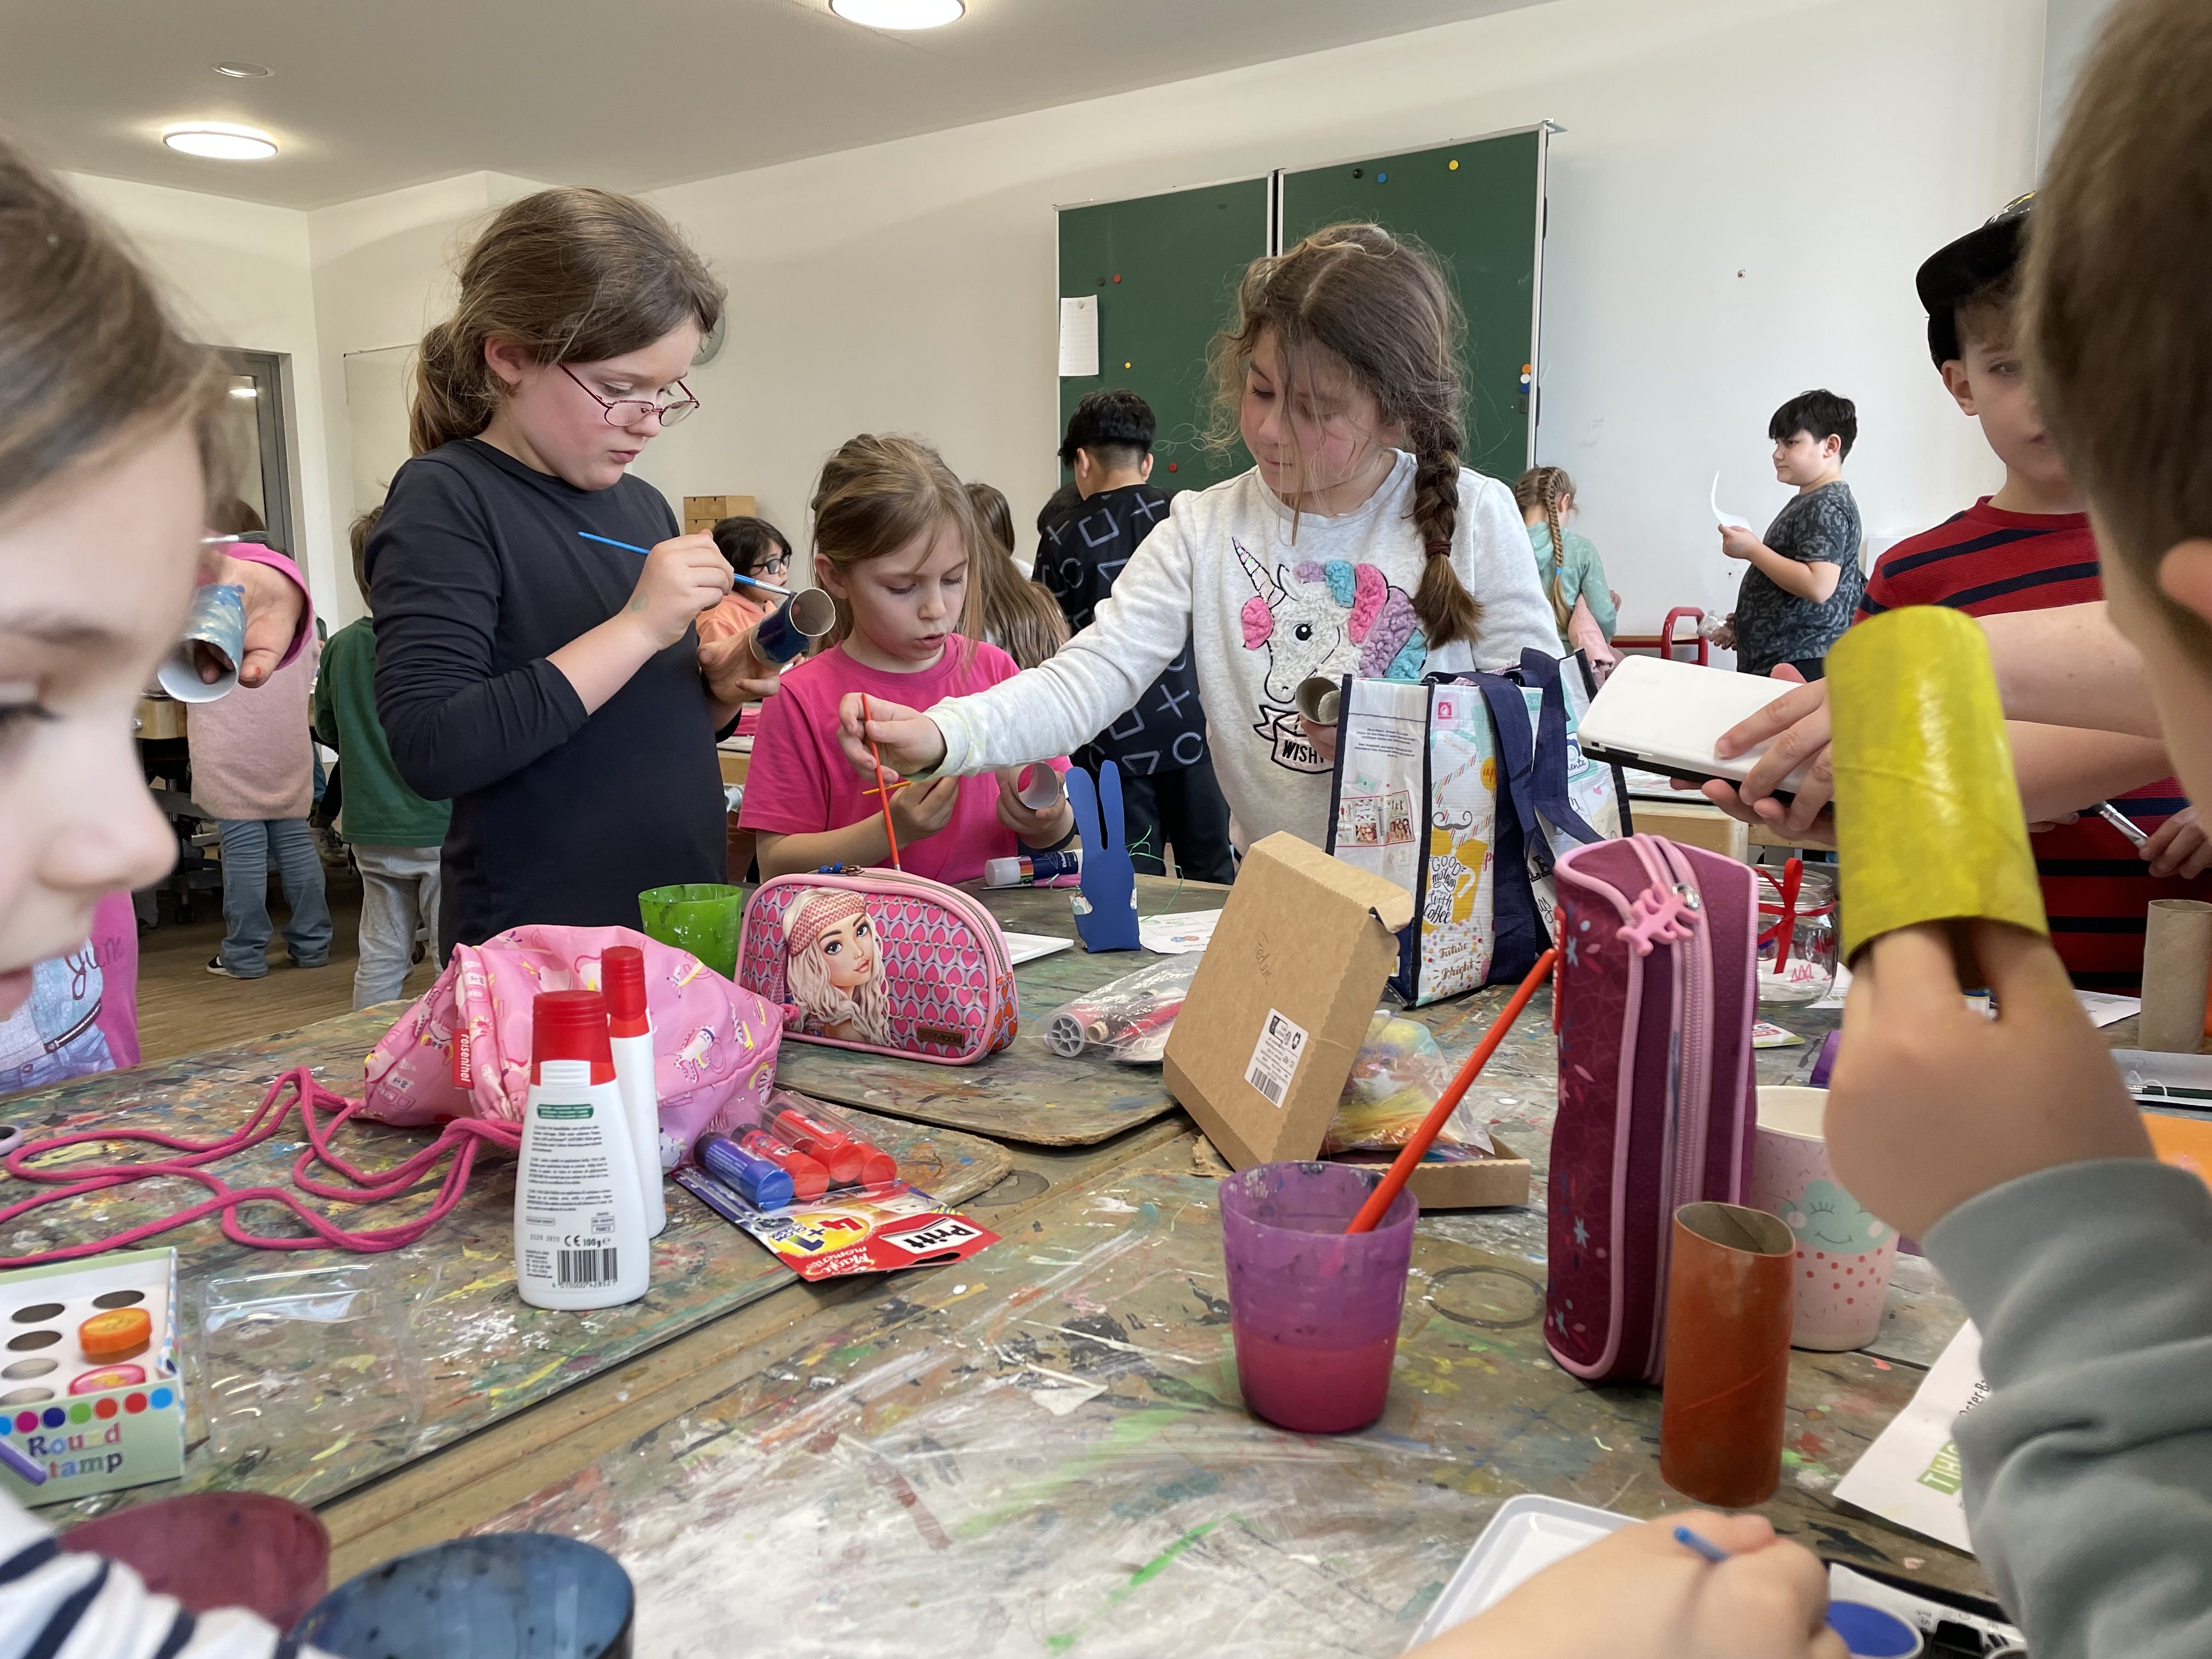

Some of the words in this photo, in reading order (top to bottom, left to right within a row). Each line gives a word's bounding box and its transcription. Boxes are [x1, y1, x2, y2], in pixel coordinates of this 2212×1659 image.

[1282, 740, 1324, 764] WISH
[1431, 855, 1462, 876] GOOD
[1423, 902, 1451, 924] Coffee
[1439, 942, 1468, 959] Future
[1441, 957, 1474, 981] Bright
[460, 1034, 471, 1083] reisenthel
[903, 1224, 976, 1249] Pritt
[29, 1423, 120, 1456] Round
[49, 1453, 122, 1478] tamp
